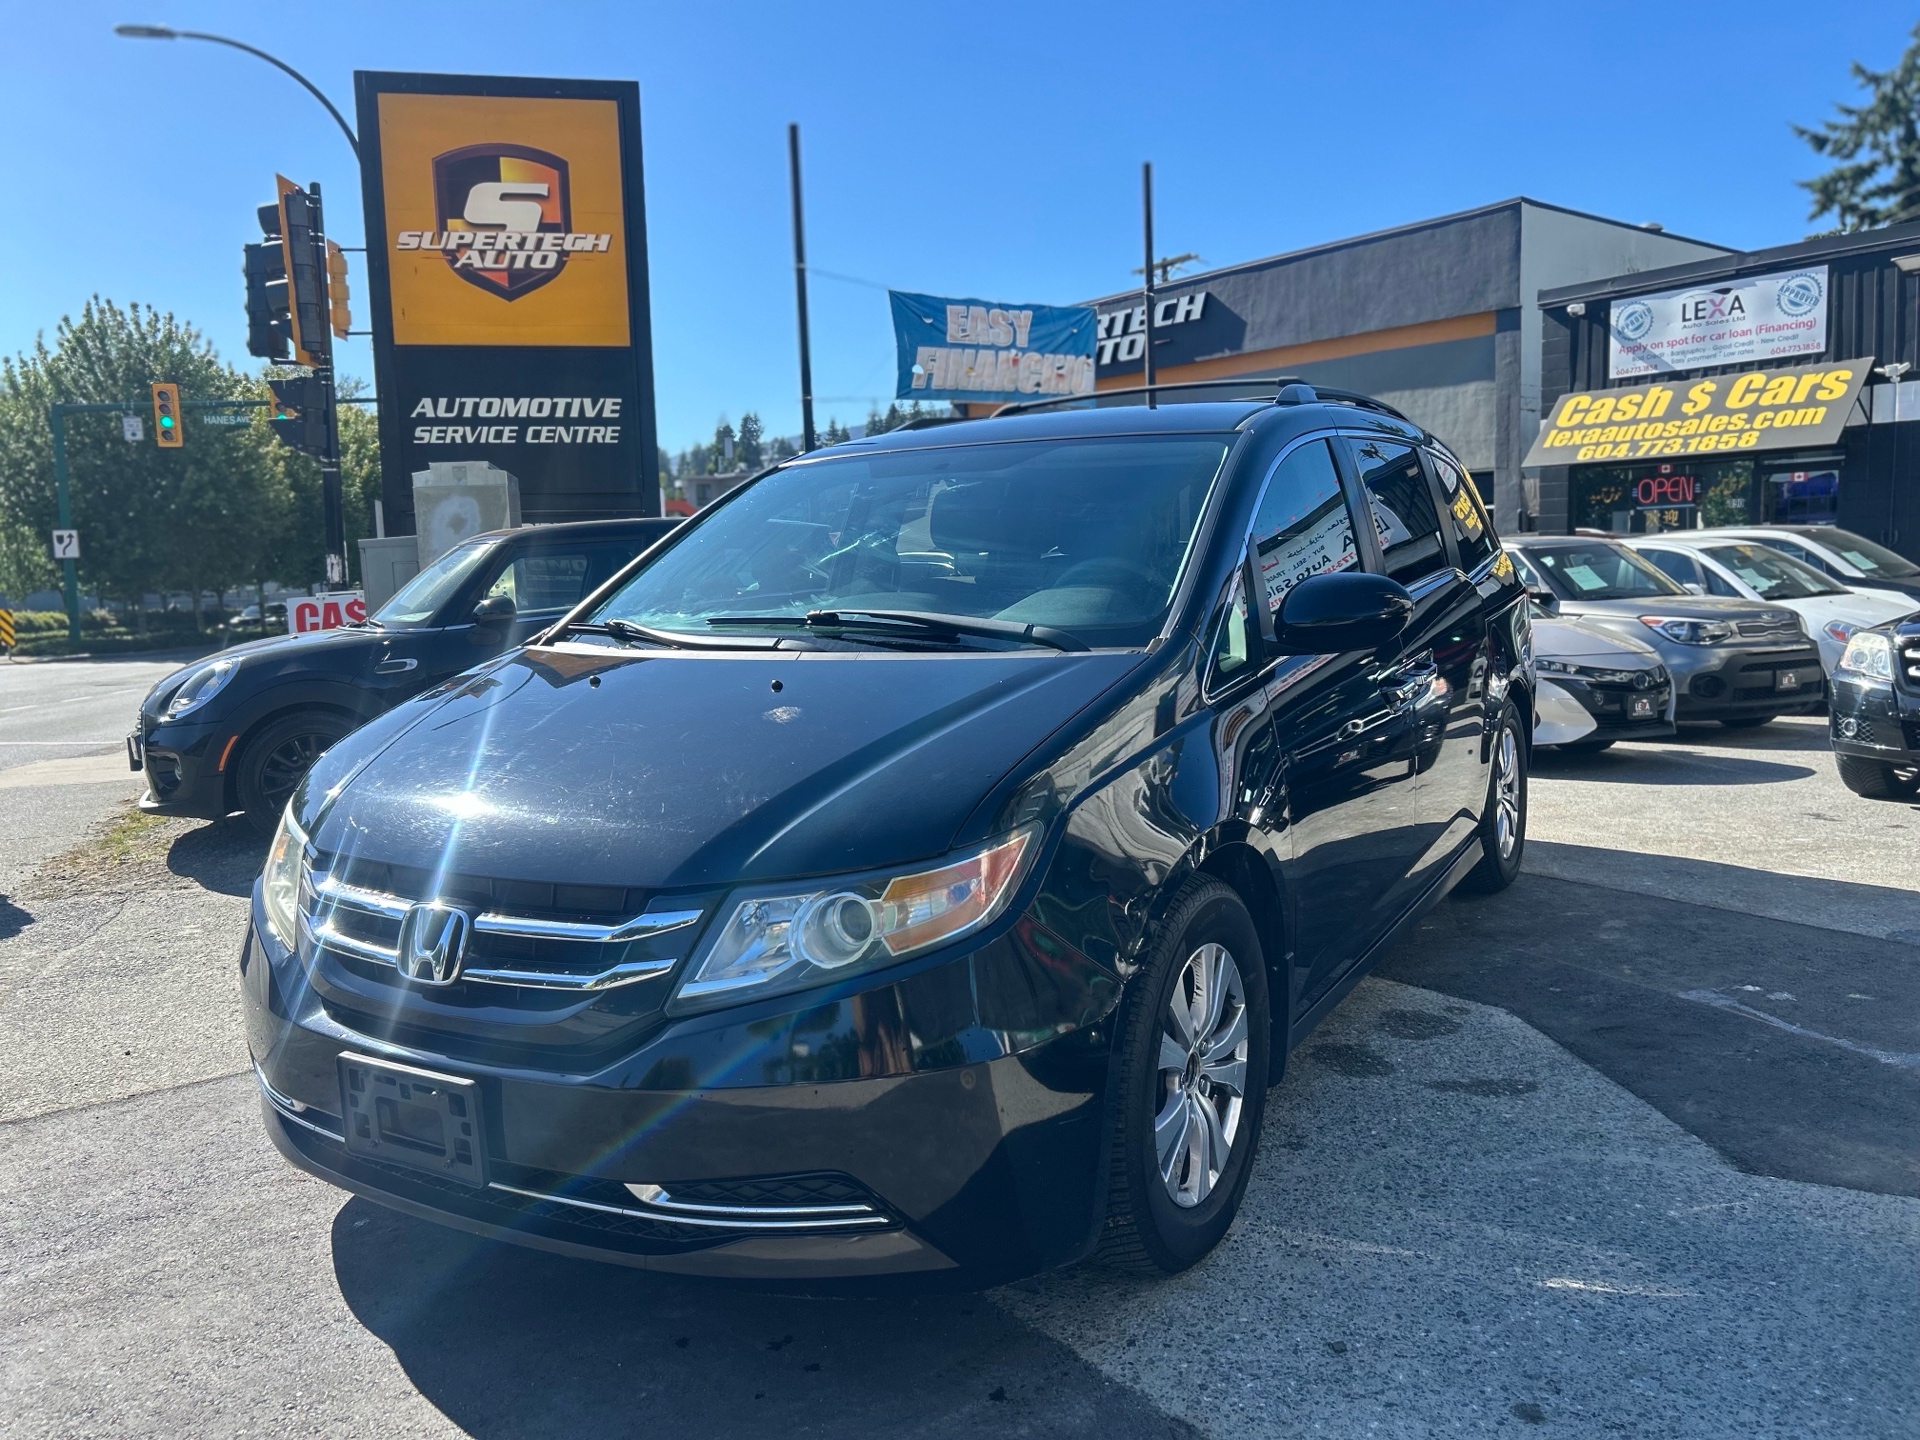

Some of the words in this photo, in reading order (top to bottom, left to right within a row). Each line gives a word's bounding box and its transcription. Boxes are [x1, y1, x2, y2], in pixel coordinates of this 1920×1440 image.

[396, 230, 612, 252] SUPERTECH
[453, 250, 558, 269] AUTO
[1682, 294, 1745, 322] LEXA
[1778, 284, 1820, 307] APPROVED
[946, 304, 1033, 347] EASY
[1097, 291, 1207, 339] RTECH
[1705, 318, 1730, 327] Sales
[1732, 315, 1746, 323] Ltd
[1096, 332, 1146, 365] TO
[1619, 342, 1648, 355] Apply
[1650, 341, 1663, 350] on
[1666, 336, 1689, 348] spot
[1691, 332, 1707, 344] for
[1709, 332, 1726, 341] car
[1729, 328, 1752, 339] loan
[1755, 317, 1817, 336] (Financing)
[1632, 354, 1644, 362] Bad
[1646, 352, 1665, 360] Credit
[1712, 342, 1732, 351] Good
[1734, 339, 1754, 348] Credit
[1761, 336, 1775, 344] New
[1777, 333, 1799, 342] Credit
[1770, 342, 1821, 355] 604-773-1858
[911, 346, 1096, 394] FINANCING
[1616, 364, 1658, 376] 604-773-1858
[1671, 357, 1685, 365] Easy
[1687, 352, 1717, 363] payment
[1723, 350, 1736, 358] Low
[1737, 348, 1754, 356] rates
[410, 397, 622, 418] AUTOMOTIVE
[1556, 386, 1673, 428] Cash
[1681, 380, 1717, 416] $
[1725, 369, 1853, 410] Cars
[204, 415, 236, 425] HANES
[237, 415, 251, 423] AVE
[1543, 406, 1828, 448] lexaautosales.com
[413, 426, 519, 444] SERVICE
[525, 426, 621, 444] CENTRE
[1576, 431, 1760, 460] 604.773.1858
[1637, 476, 1694, 503] OPEN
